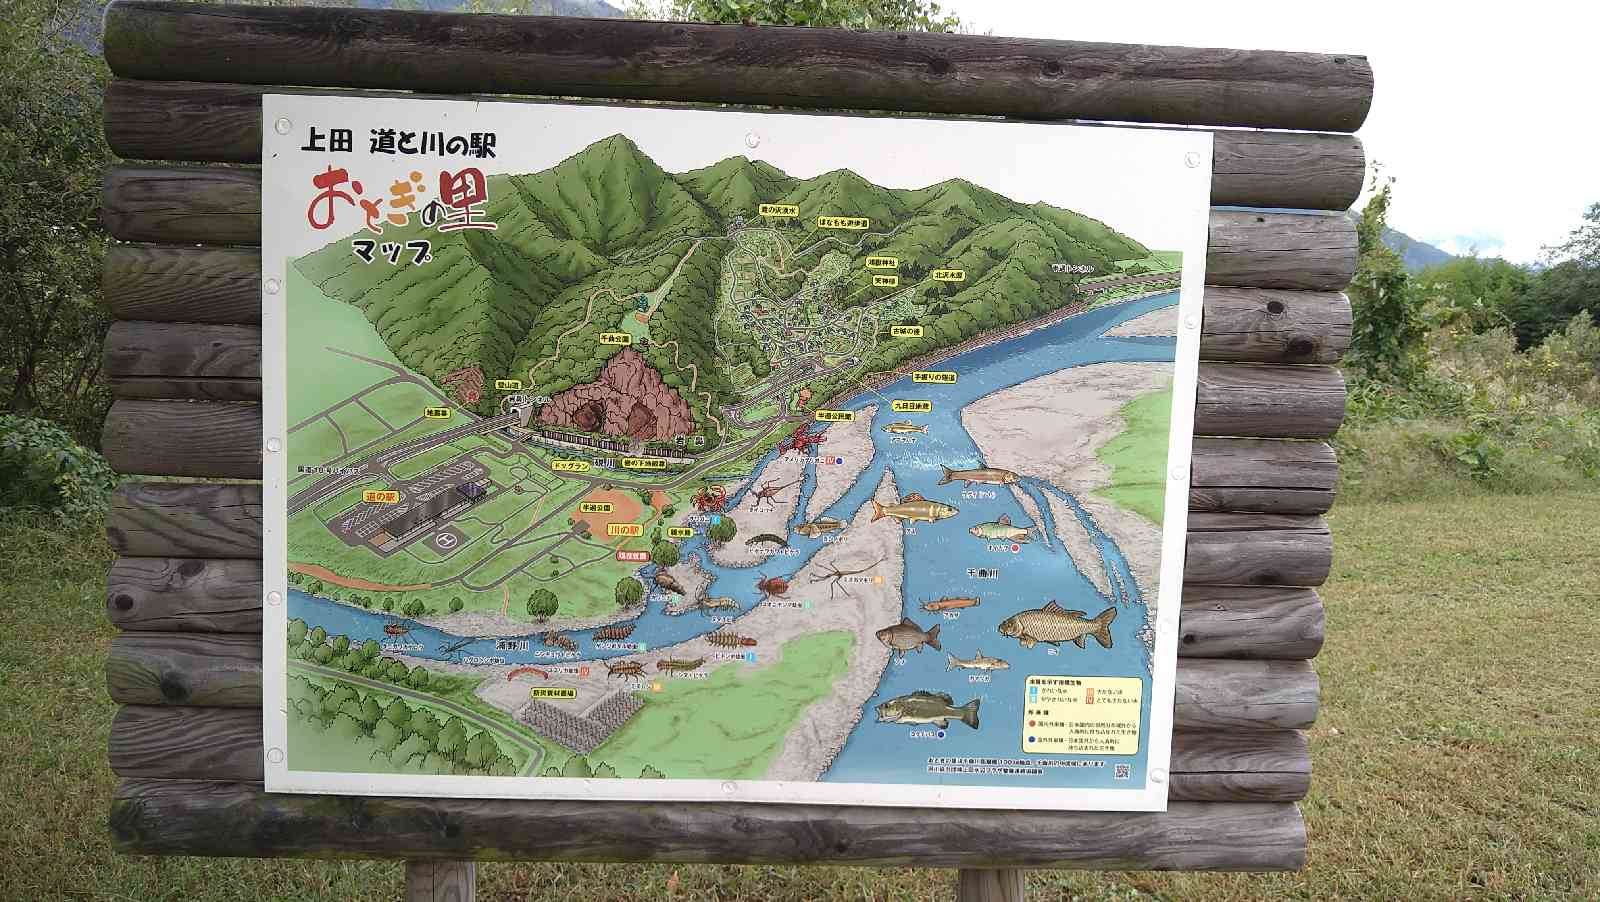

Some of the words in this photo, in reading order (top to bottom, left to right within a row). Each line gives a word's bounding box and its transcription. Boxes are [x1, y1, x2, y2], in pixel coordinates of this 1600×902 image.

[301, 127, 353, 153] 上田
[370, 128, 497, 158] 道と川の駅
[308, 165, 497, 231] おとぎの里
[353, 240, 432, 264] マップ
[366, 492, 396, 502] 道の駅
[610, 525, 640, 535] 川の駅
[967, 568, 999, 580] 千曲川
